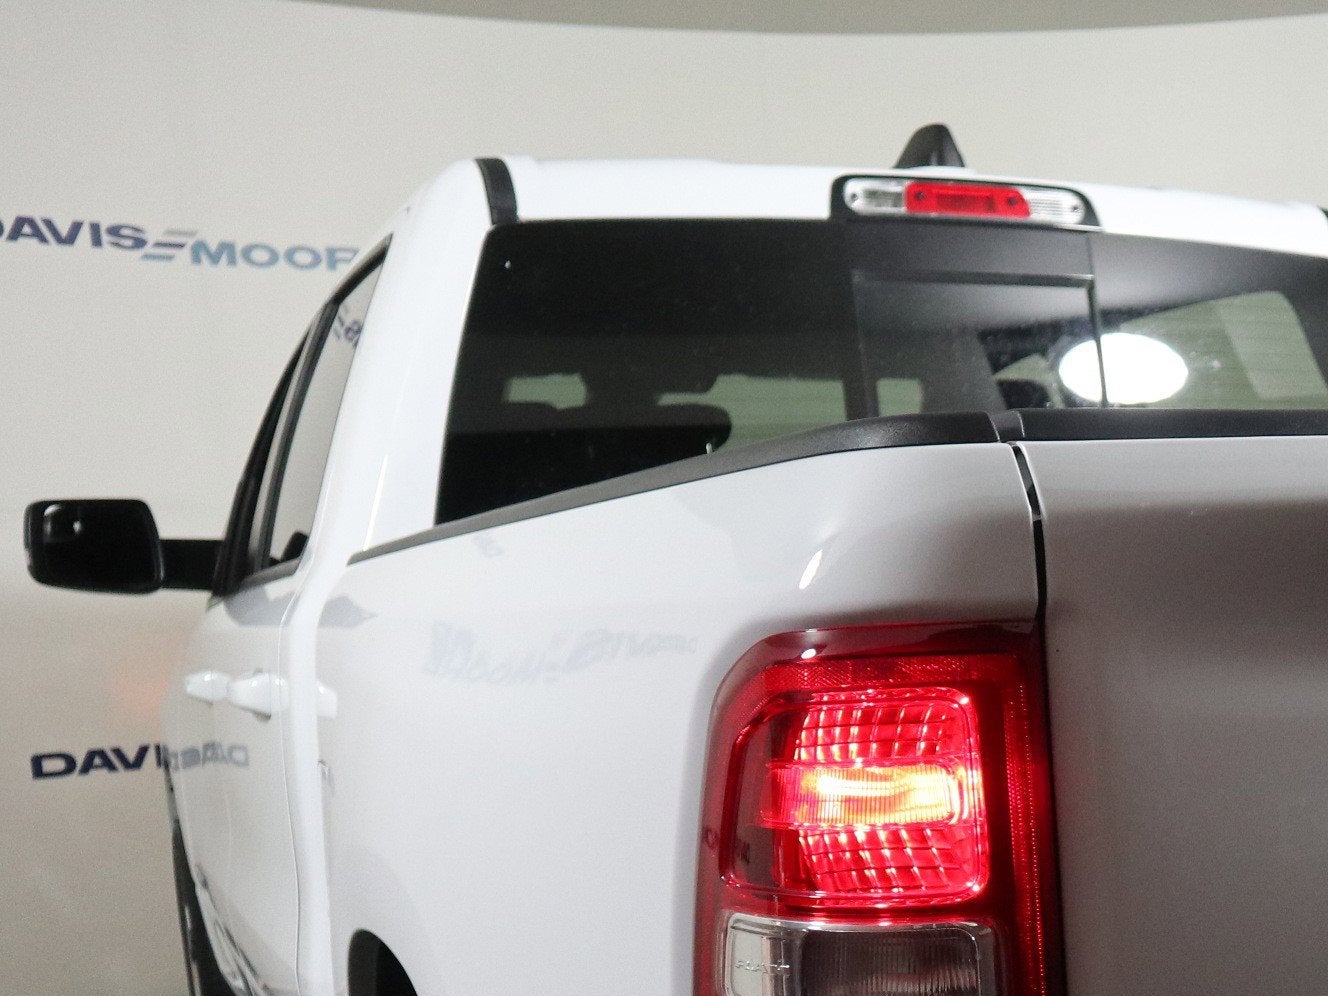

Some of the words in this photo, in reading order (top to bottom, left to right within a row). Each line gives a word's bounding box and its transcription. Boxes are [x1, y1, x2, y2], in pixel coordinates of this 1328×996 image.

[0, 215, 148, 251] AVIS
[190, 240, 360, 271] MOOR
[30, 743, 163, 780] DAVI
